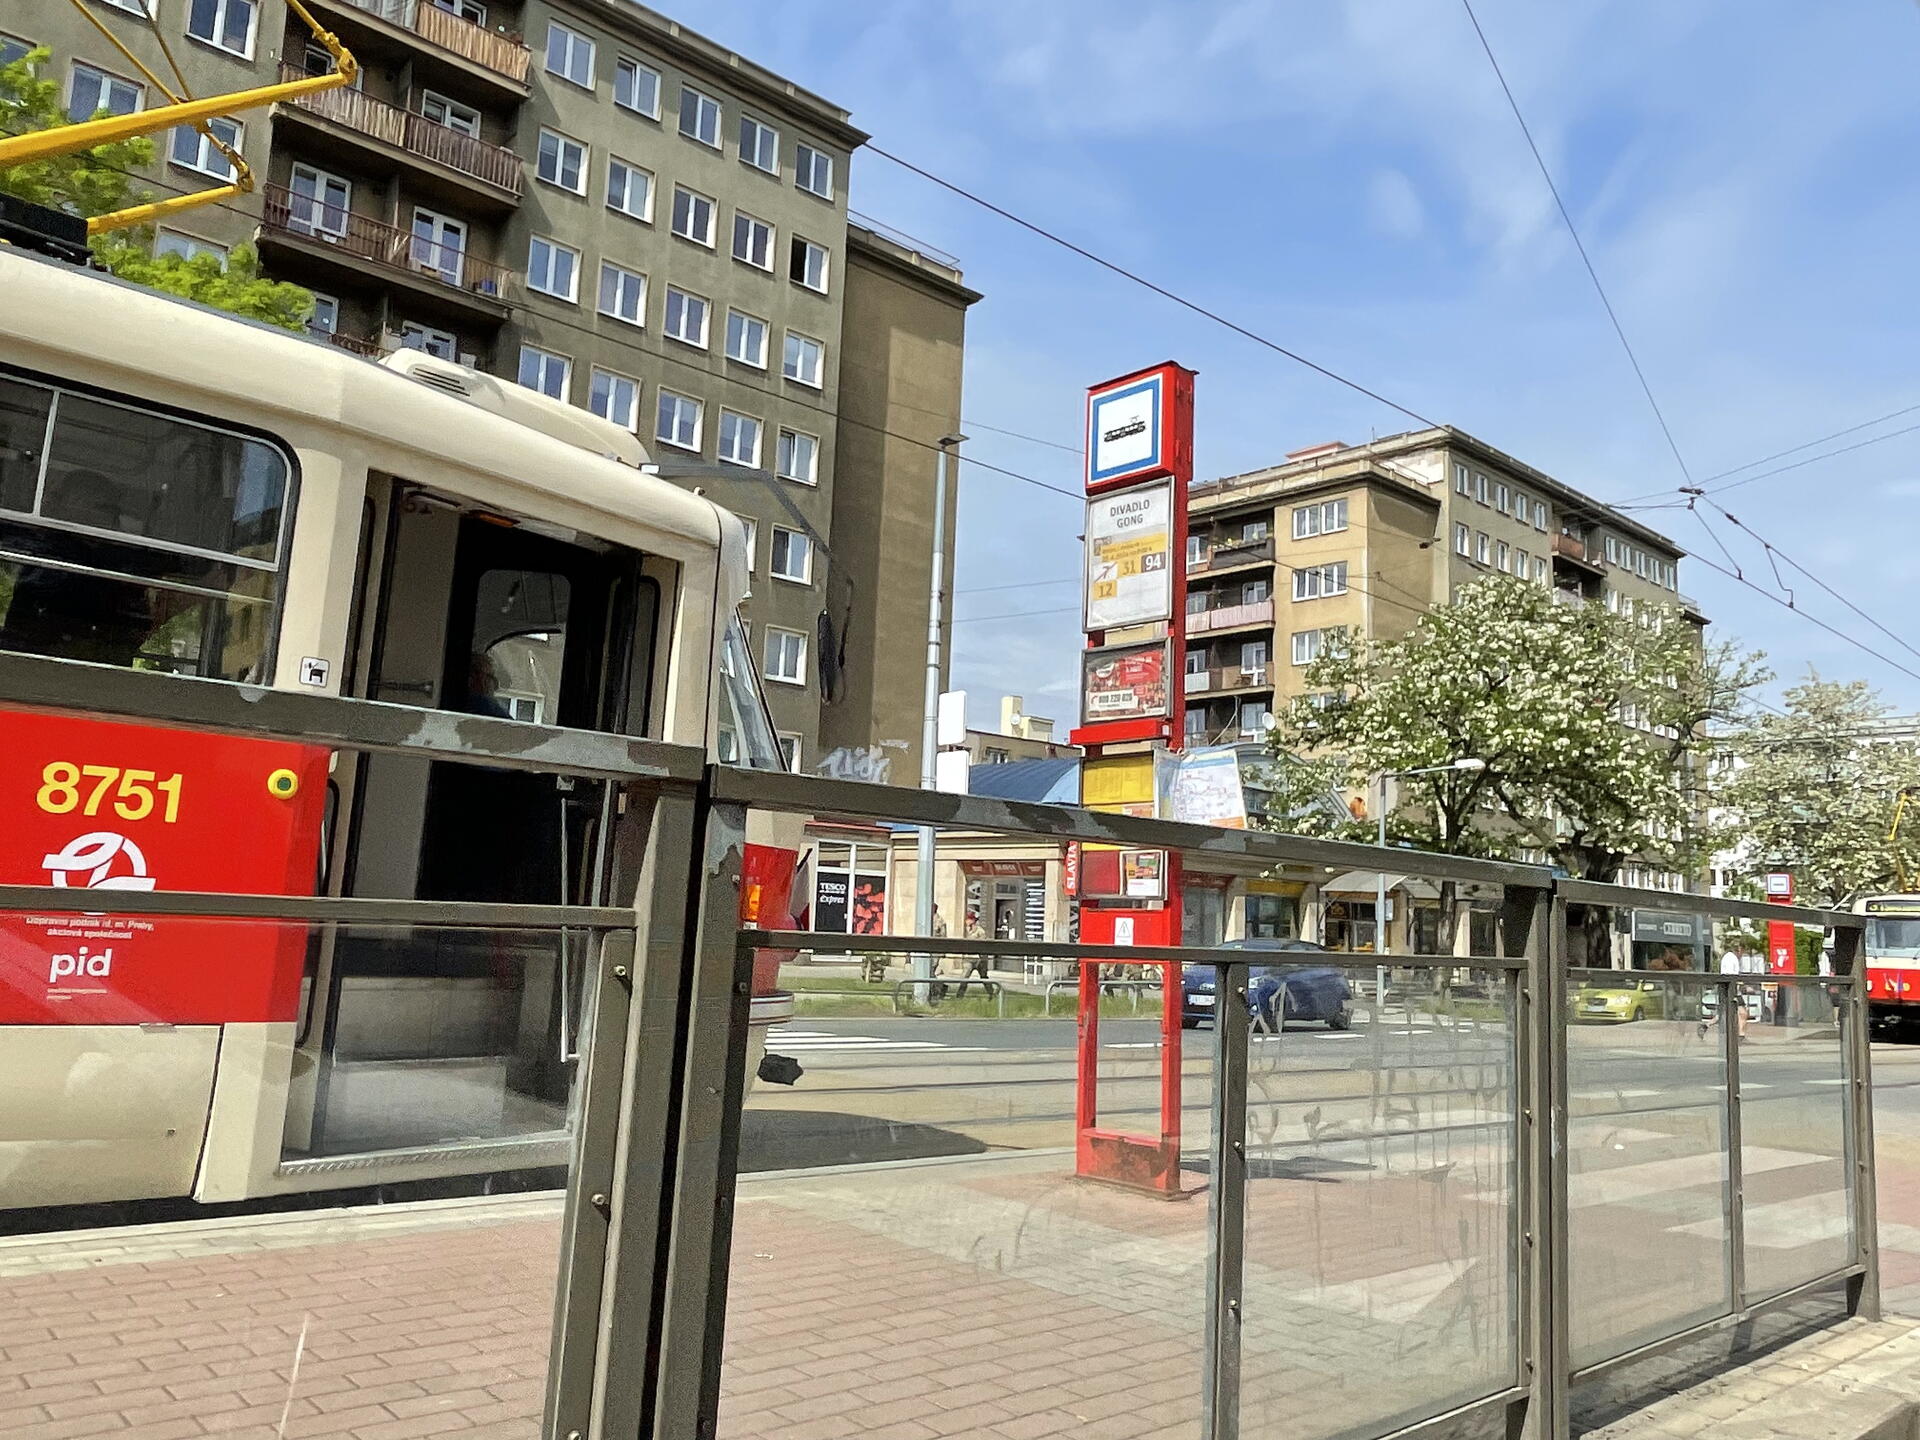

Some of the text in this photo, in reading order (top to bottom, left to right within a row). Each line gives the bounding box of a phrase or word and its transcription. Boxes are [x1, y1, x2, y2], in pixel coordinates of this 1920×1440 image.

[1110, 499, 1150, 517] DIVADLO
[1116, 514, 1144, 528] GONG
[1145, 554, 1162, 571] 94
[1098, 582, 1113, 598] 12
[36, 761, 183, 824] 8751
[1066, 842, 1078, 889] SLAVIA
[819, 882, 847, 891] TESCO
[49, 946, 113, 983] pid
